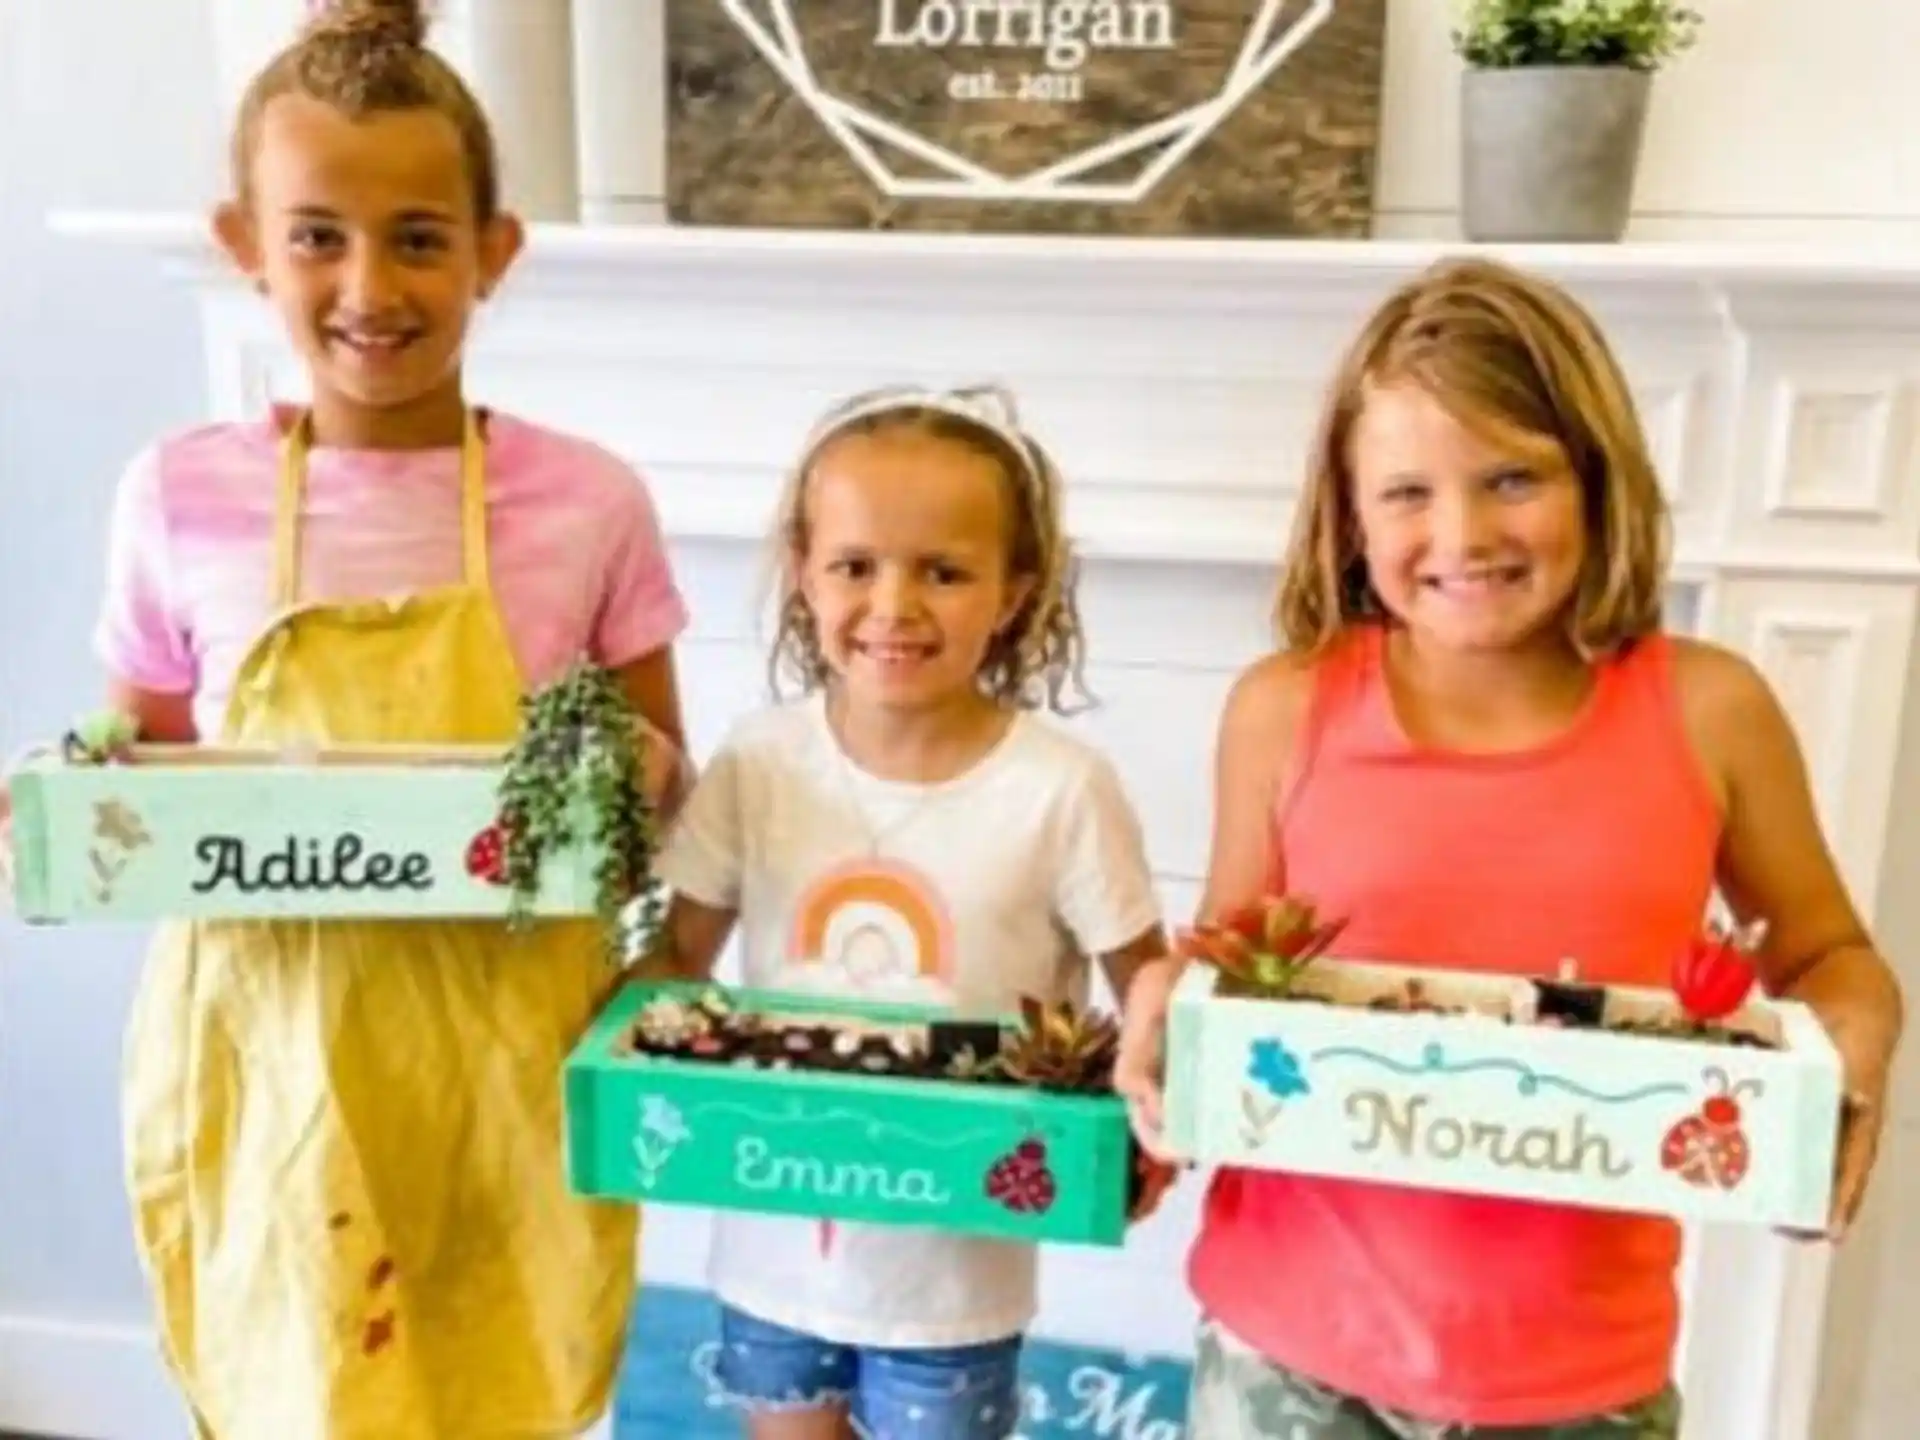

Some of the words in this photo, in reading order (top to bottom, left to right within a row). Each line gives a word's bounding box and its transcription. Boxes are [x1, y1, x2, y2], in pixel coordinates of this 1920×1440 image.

[191, 831, 436, 895] Adilee
[1345, 1089, 1632, 1178] Norah
[733, 1136, 952, 1205] Emma
